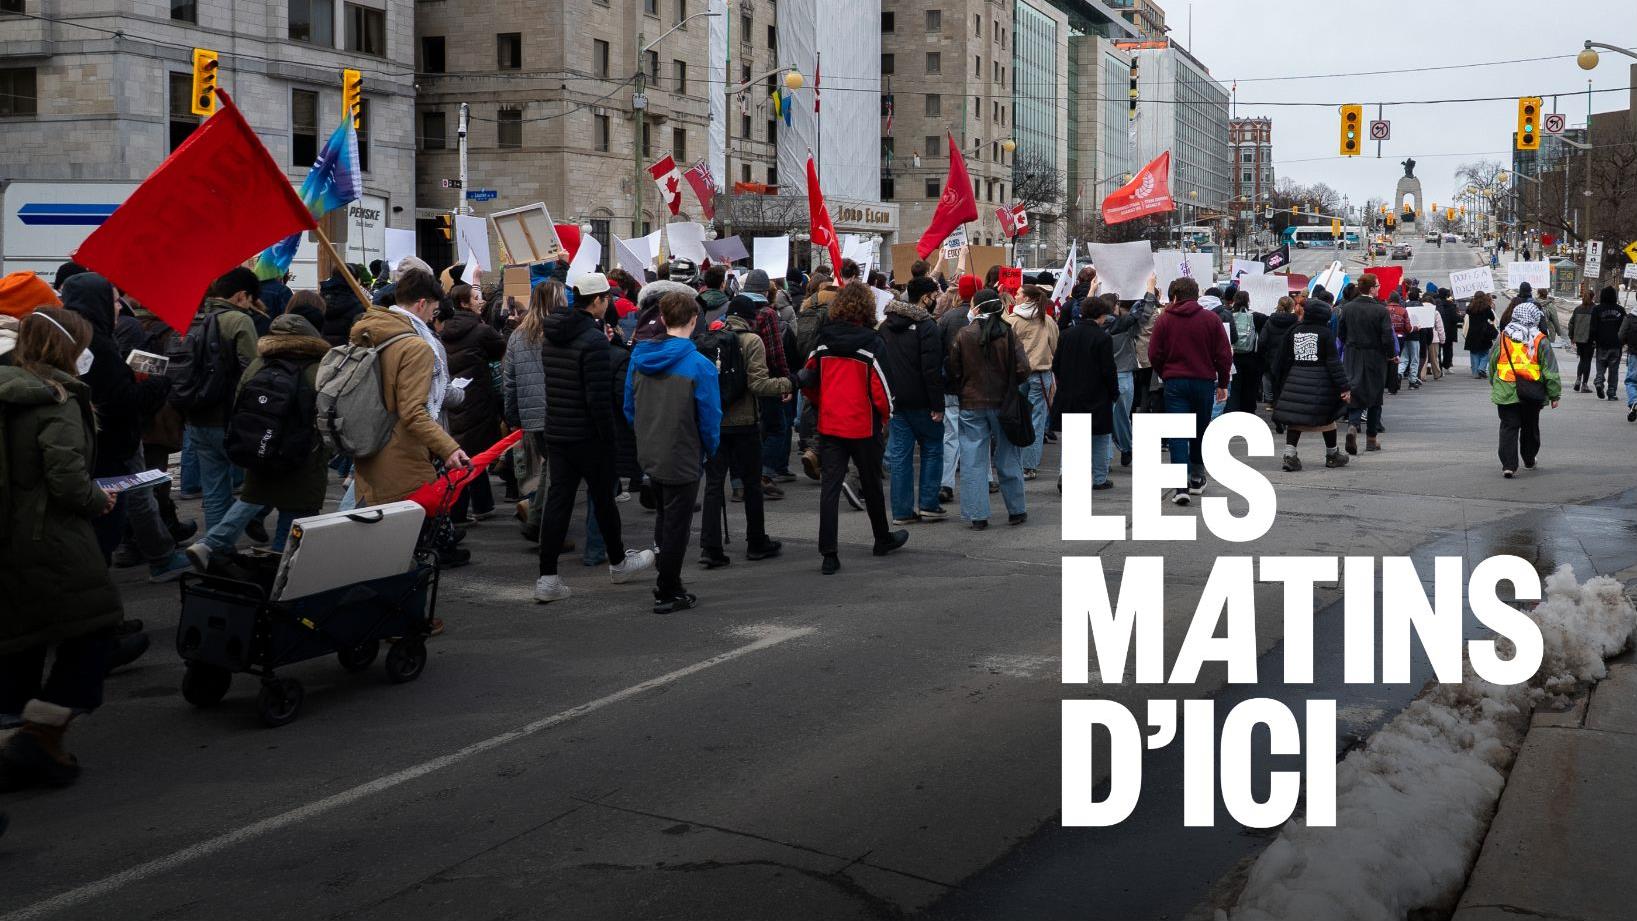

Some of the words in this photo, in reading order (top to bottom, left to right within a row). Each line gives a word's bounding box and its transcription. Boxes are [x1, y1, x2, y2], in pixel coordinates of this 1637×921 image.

[349, 206, 381, 221] PENSKE
[838, 205, 863, 223] LORD
[865, 207, 890, 224] ELGIN
